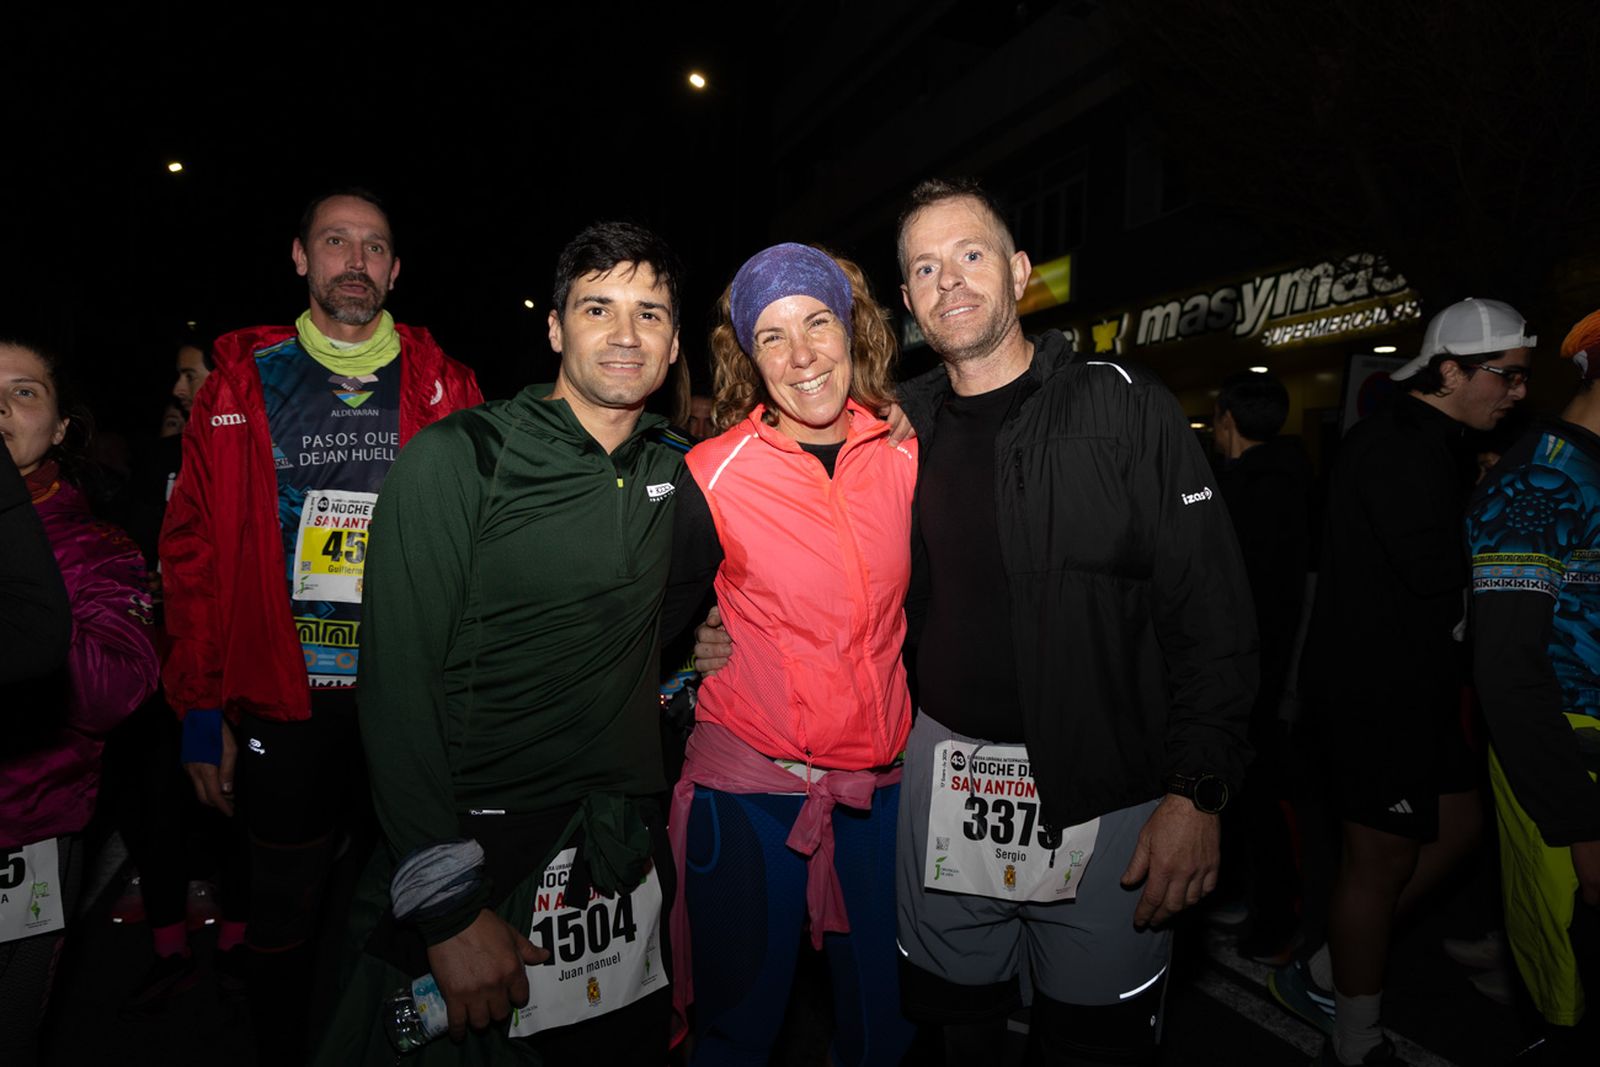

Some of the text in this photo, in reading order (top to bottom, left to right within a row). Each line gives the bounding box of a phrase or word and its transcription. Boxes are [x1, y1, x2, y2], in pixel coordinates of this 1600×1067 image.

[1136, 252, 1408, 345] masymas
[211, 413, 246, 426] om
[331, 408, 379, 417] ALDEVARAN
[302, 431, 399, 449] PASOS QUE
[299, 450, 348, 466] DEJAN
[352, 447, 395, 461] HUELL
[1181, 489, 1209, 505] izas
[330, 503, 370, 515] NOCHE
[314, 515, 368, 529] SAN ANT
[322, 531, 366, 562] 45
[328, 564, 364, 575] Guillerm
[971, 760, 1015, 776] NOCHE
[951, 775, 1037, 798] SAN ANTÓN
[995, 847, 1027, 863] Sergio
[533, 893, 637, 966] 1504
[558, 952, 622, 982] Juan manuel
